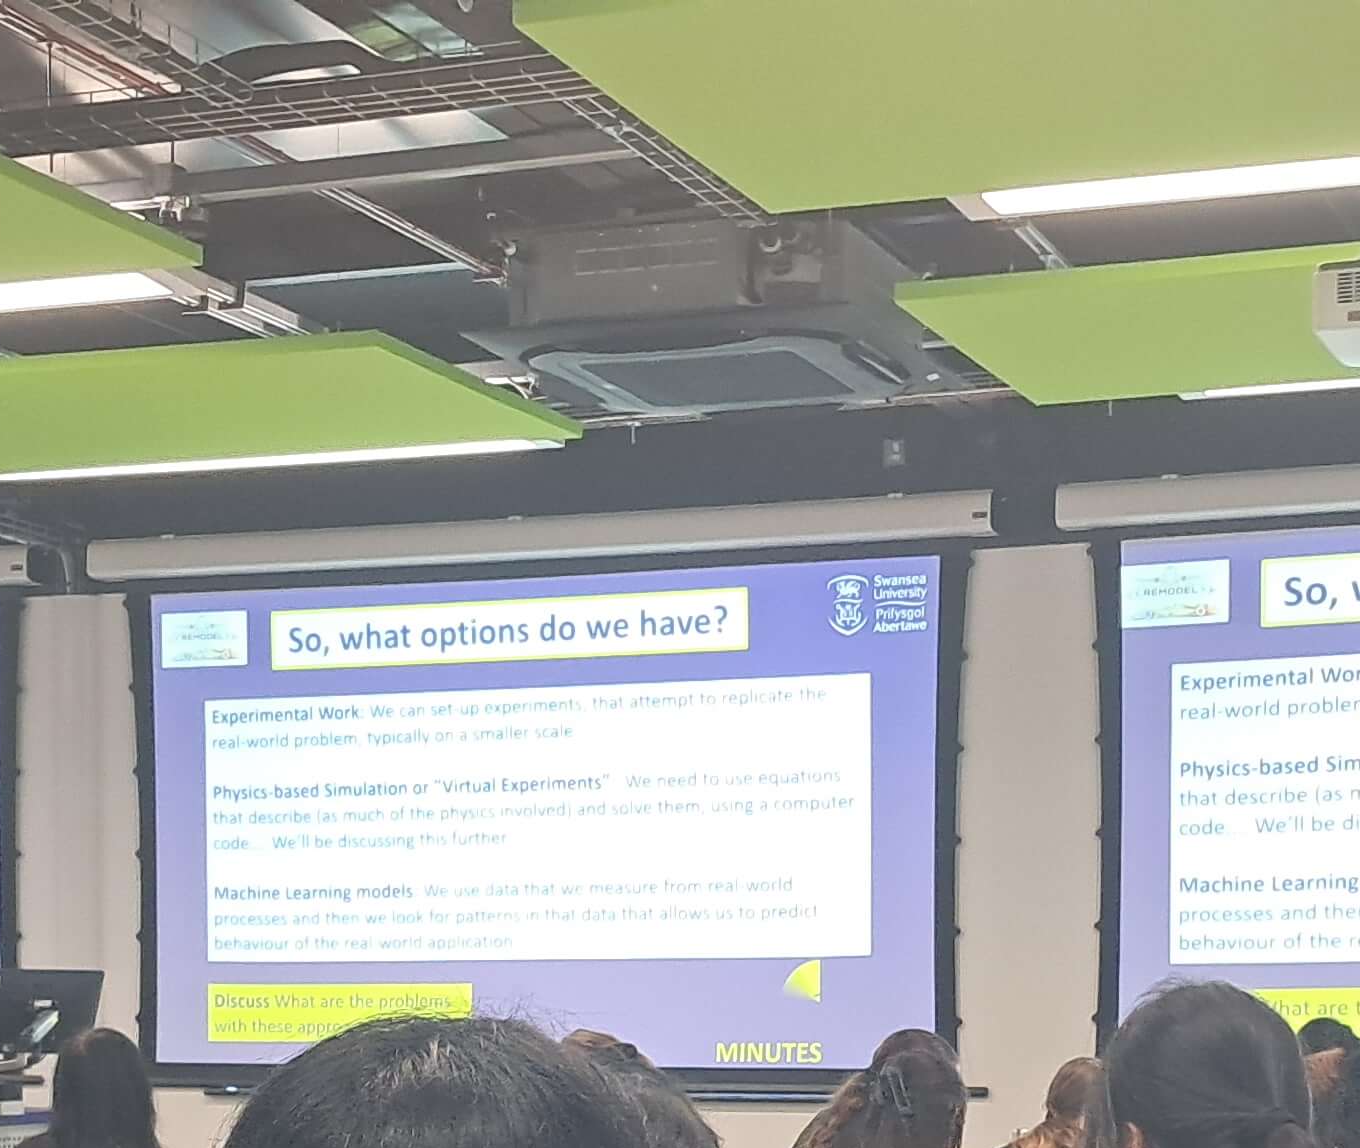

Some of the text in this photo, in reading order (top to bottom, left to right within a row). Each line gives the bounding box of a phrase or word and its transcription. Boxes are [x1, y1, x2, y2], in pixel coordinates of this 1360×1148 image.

[1283, 575, 1337, 610] So,
[287, 604, 728, 657] So, what options do we have?
[1178, 665, 1315, 696] Experimental
[210, 704, 314, 728] Experimental
[1178, 697, 1281, 721] real-world
[1178, 754, 1320, 782] Physics-based
[211, 781, 320, 804] Physics-based
[322, 779, 408, 799] Simulation
[411, 782, 429, 796] or
[1178, 788, 1218, 808] that
[1223, 784, 1308, 806] describe
[1314, 784, 1343, 806] (as
[1310, 814, 1336, 833] be
[212, 883, 281, 901] Machine
[284, 884, 352, 904] Learning
[1177, 873, 1265, 894] Machine
[1270, 871, 1360, 895] Learning
[1177, 907, 1273, 926] processes
[1279, 902, 1317, 921] and
[1177, 933, 1276, 951] behaviour
[1282, 930, 1302, 950] of
[1308, 931, 1342, 949] the
[214, 993, 451, 1011] Discuss What are the problems
[1271, 999, 1311, 1016] hat
[1317, 1002, 1348, 1016] are
[214, 1019, 247, 1034] with
[251, 1018, 293, 1034] these
[716, 1042, 822, 1063] MINUTES
